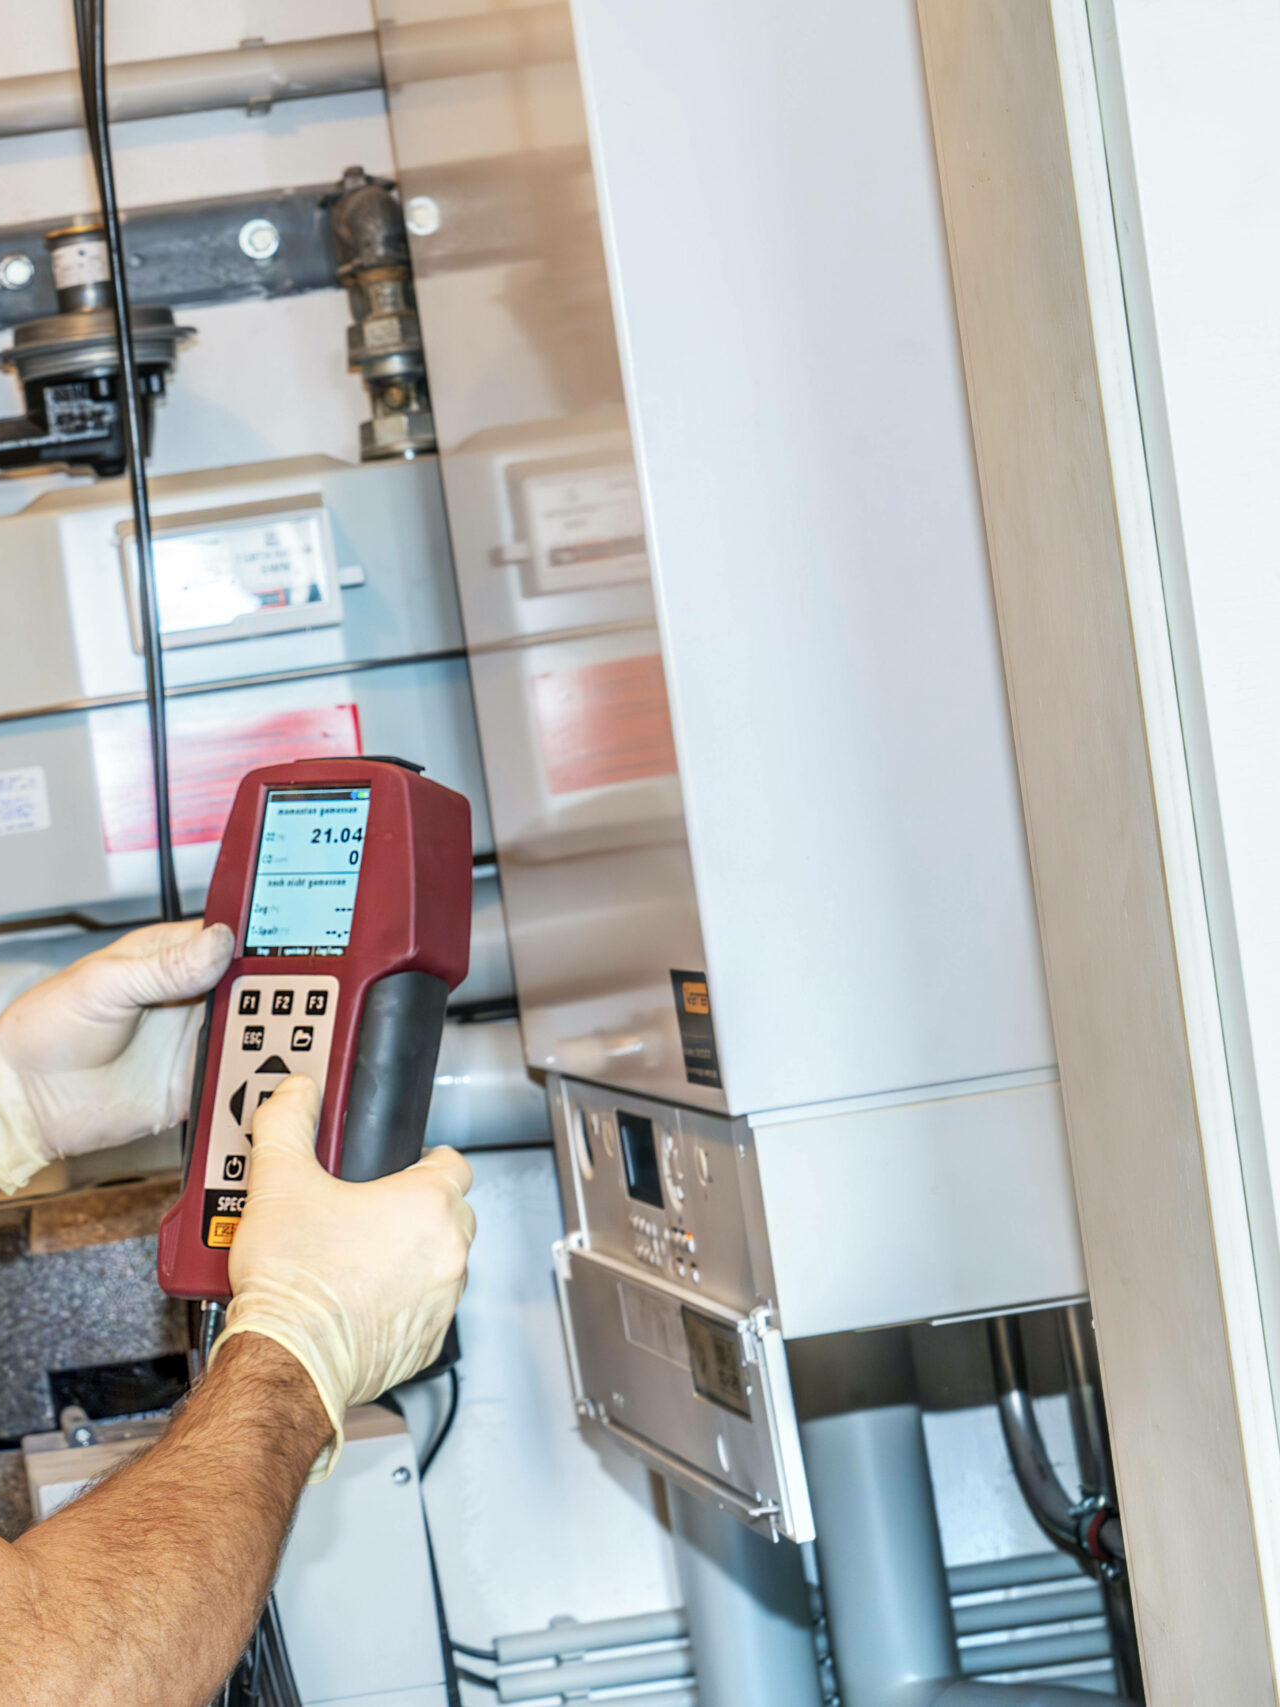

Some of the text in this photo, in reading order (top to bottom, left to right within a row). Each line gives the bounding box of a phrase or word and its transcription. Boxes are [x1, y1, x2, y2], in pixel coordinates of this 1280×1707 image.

[310, 827, 364, 844] 21.04
[348, 849, 360, 866] 0
[242, 995, 257, 1010] F1
[275, 995, 291, 1010] F2
[308, 995, 325, 1010] F3
